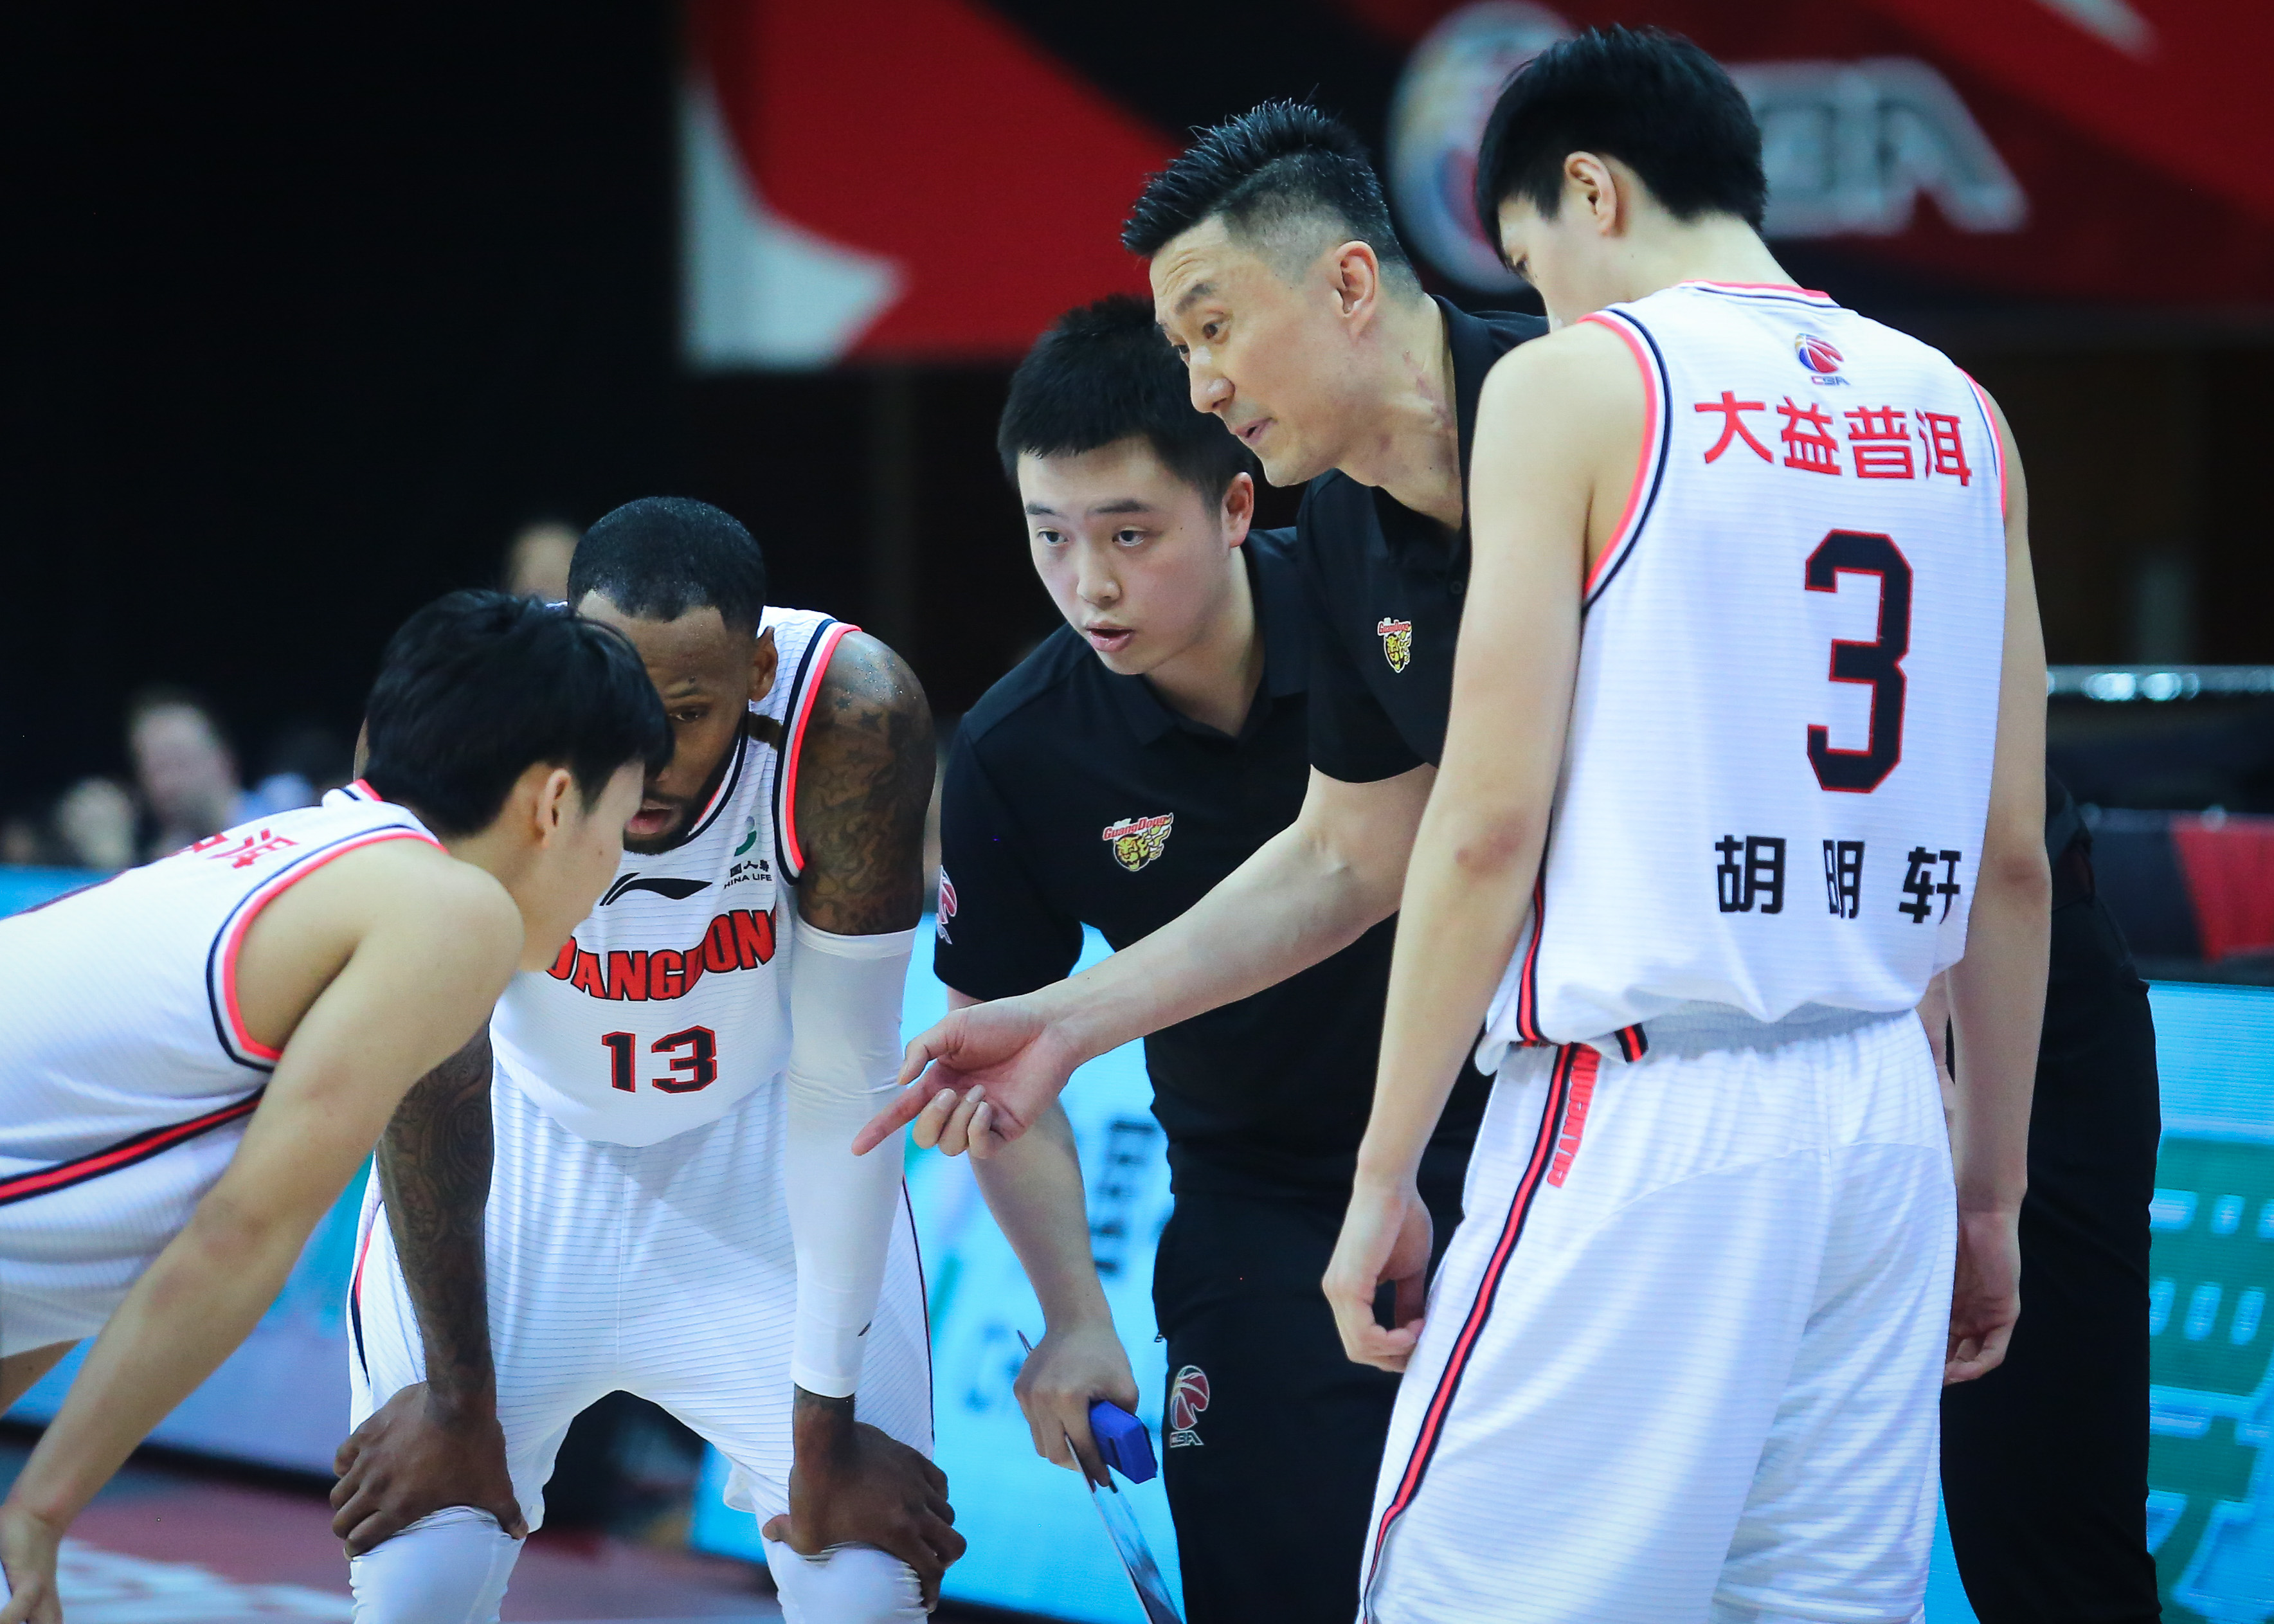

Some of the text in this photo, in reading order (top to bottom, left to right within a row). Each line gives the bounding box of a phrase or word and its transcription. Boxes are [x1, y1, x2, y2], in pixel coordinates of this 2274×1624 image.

[1729, 57, 2029, 238] BA
[1811, 375, 1850, 386] CBA
[1694, 390, 1972, 487] 大益普洱
[1805, 528, 1913, 794] 3
[723, 873, 772, 890] HINA LIFE
[1715, 835, 1962, 925] 胡明轩
[602, 1025, 717, 1094] 13
